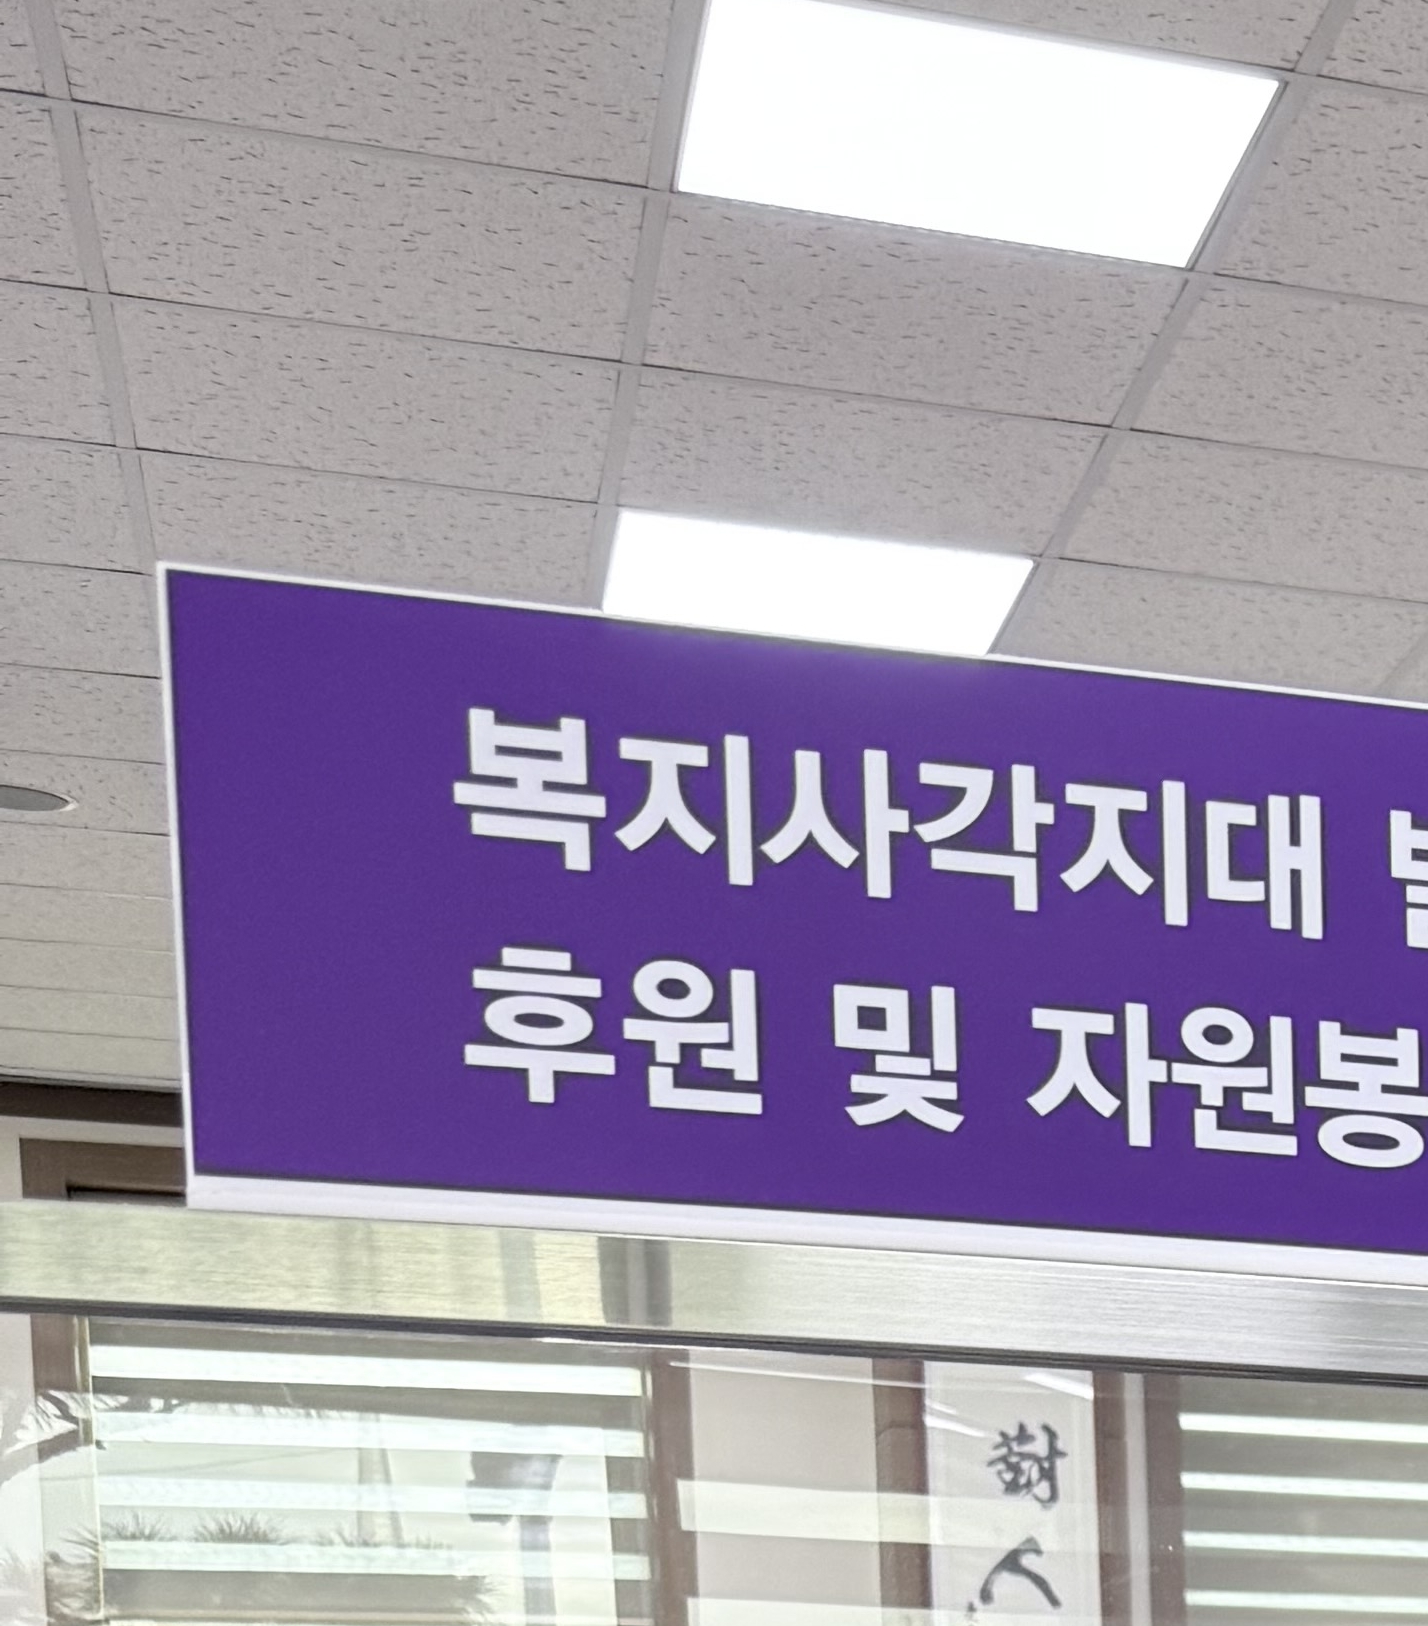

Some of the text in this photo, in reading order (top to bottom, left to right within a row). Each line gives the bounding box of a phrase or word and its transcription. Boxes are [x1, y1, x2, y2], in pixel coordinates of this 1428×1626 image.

[453, 708, 1322, 938] 복지사각지대
[465, 947, 762, 1114] 후원
[833, 984, 964, 1132] 및
